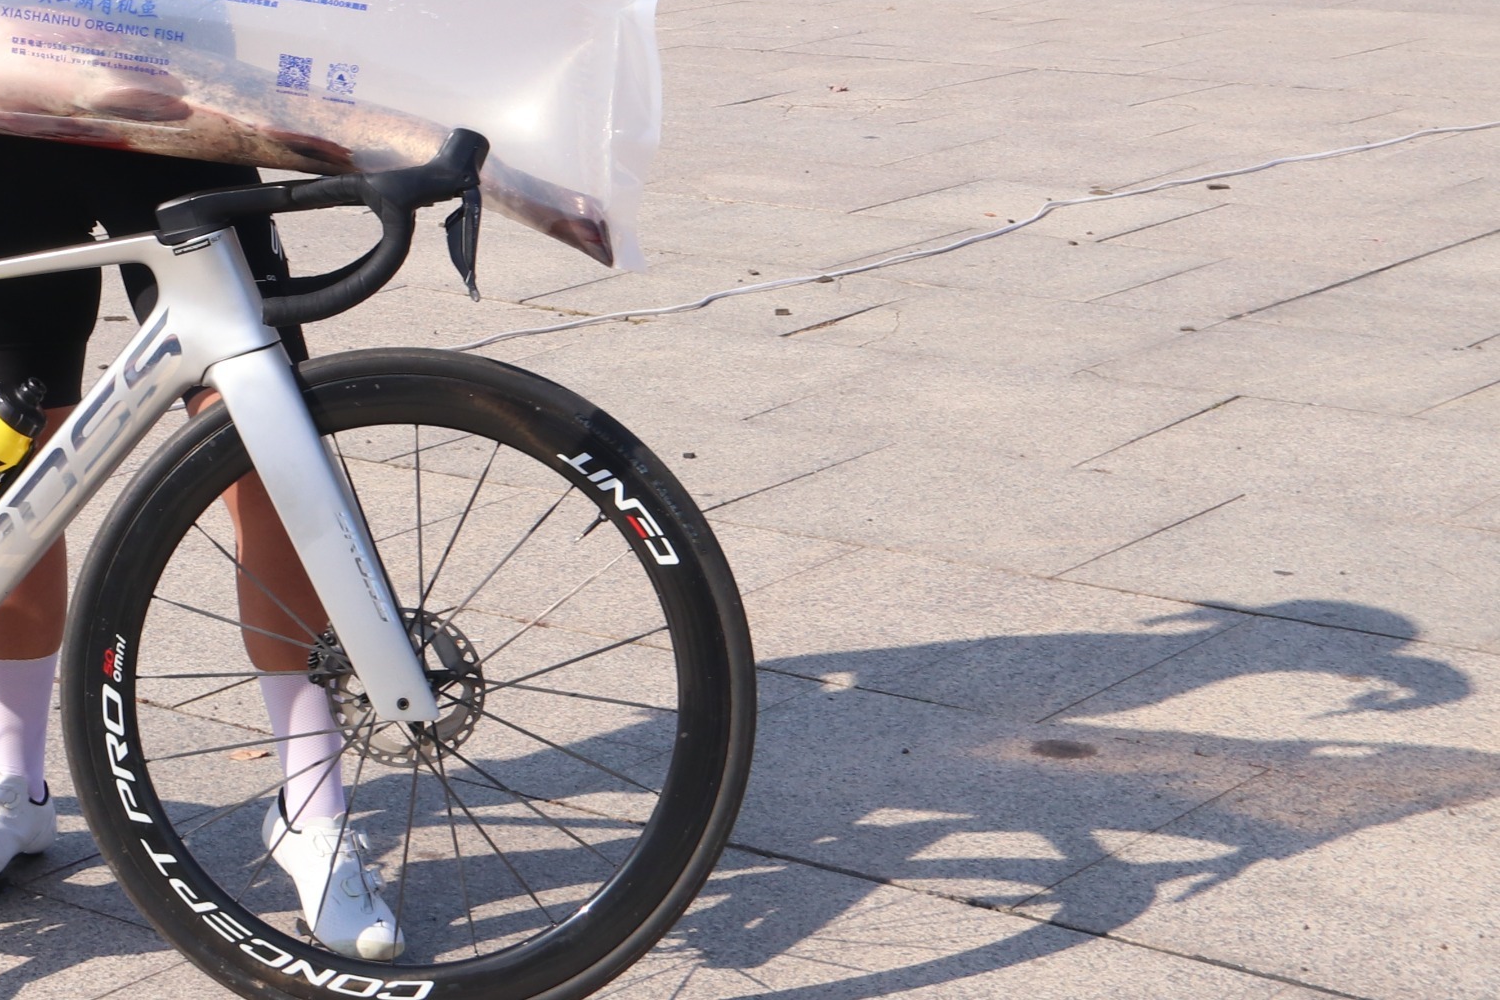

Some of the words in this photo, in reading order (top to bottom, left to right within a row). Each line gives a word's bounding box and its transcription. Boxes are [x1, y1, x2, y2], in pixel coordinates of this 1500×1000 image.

[0, 6, 81, 28] XIASHANHU
[84, 18, 149, 38] ORGANIC
[153, 28, 185, 42] FISH
[556, 452, 680, 565] CENIT
[112, 633, 128, 684] omni
[102, 683, 154, 824] PRO
[139, 838, 435, 1000] CONCEPT
